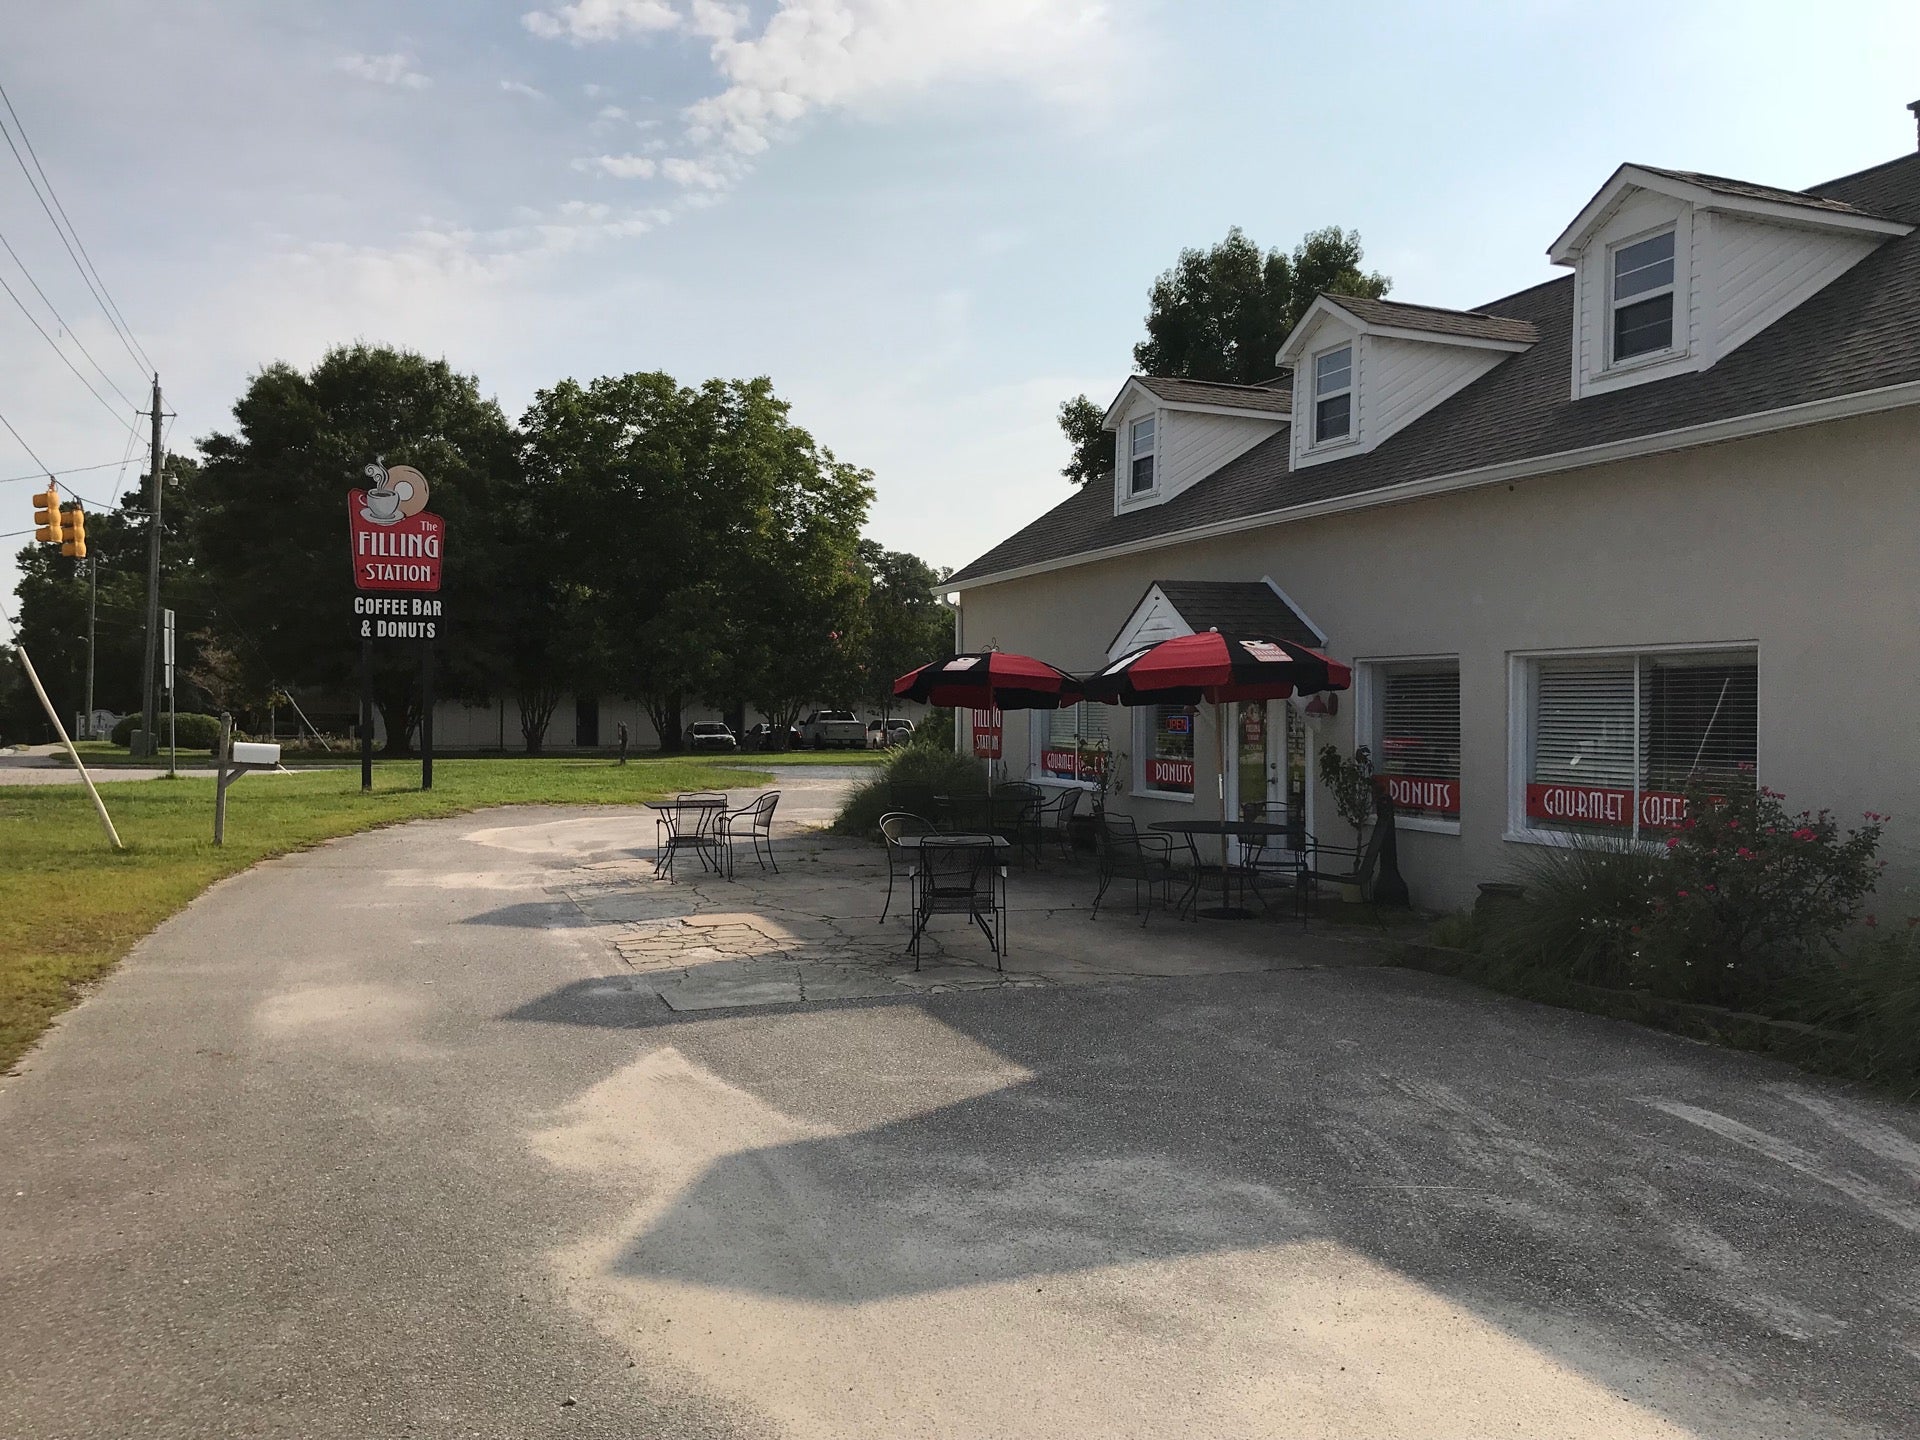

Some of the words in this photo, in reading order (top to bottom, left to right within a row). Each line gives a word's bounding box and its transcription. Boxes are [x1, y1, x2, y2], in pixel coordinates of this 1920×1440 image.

[420, 520, 438, 532] The
[359, 531, 439, 558] FILLING
[366, 563, 431, 582] STATION
[354, 596, 408, 615] COFFEE
[412, 598, 442, 616] BAR
[360, 619, 372, 637] &
[377, 620, 436, 639] DONUTS
[1166, 718, 1187, 730] OPEN
[976, 734, 999, 750] STATIN
[1155, 762, 1192, 783] DONUTS
[1389, 779, 1451, 808] DONUTS
[1543, 788, 1625, 822] GOURMET
